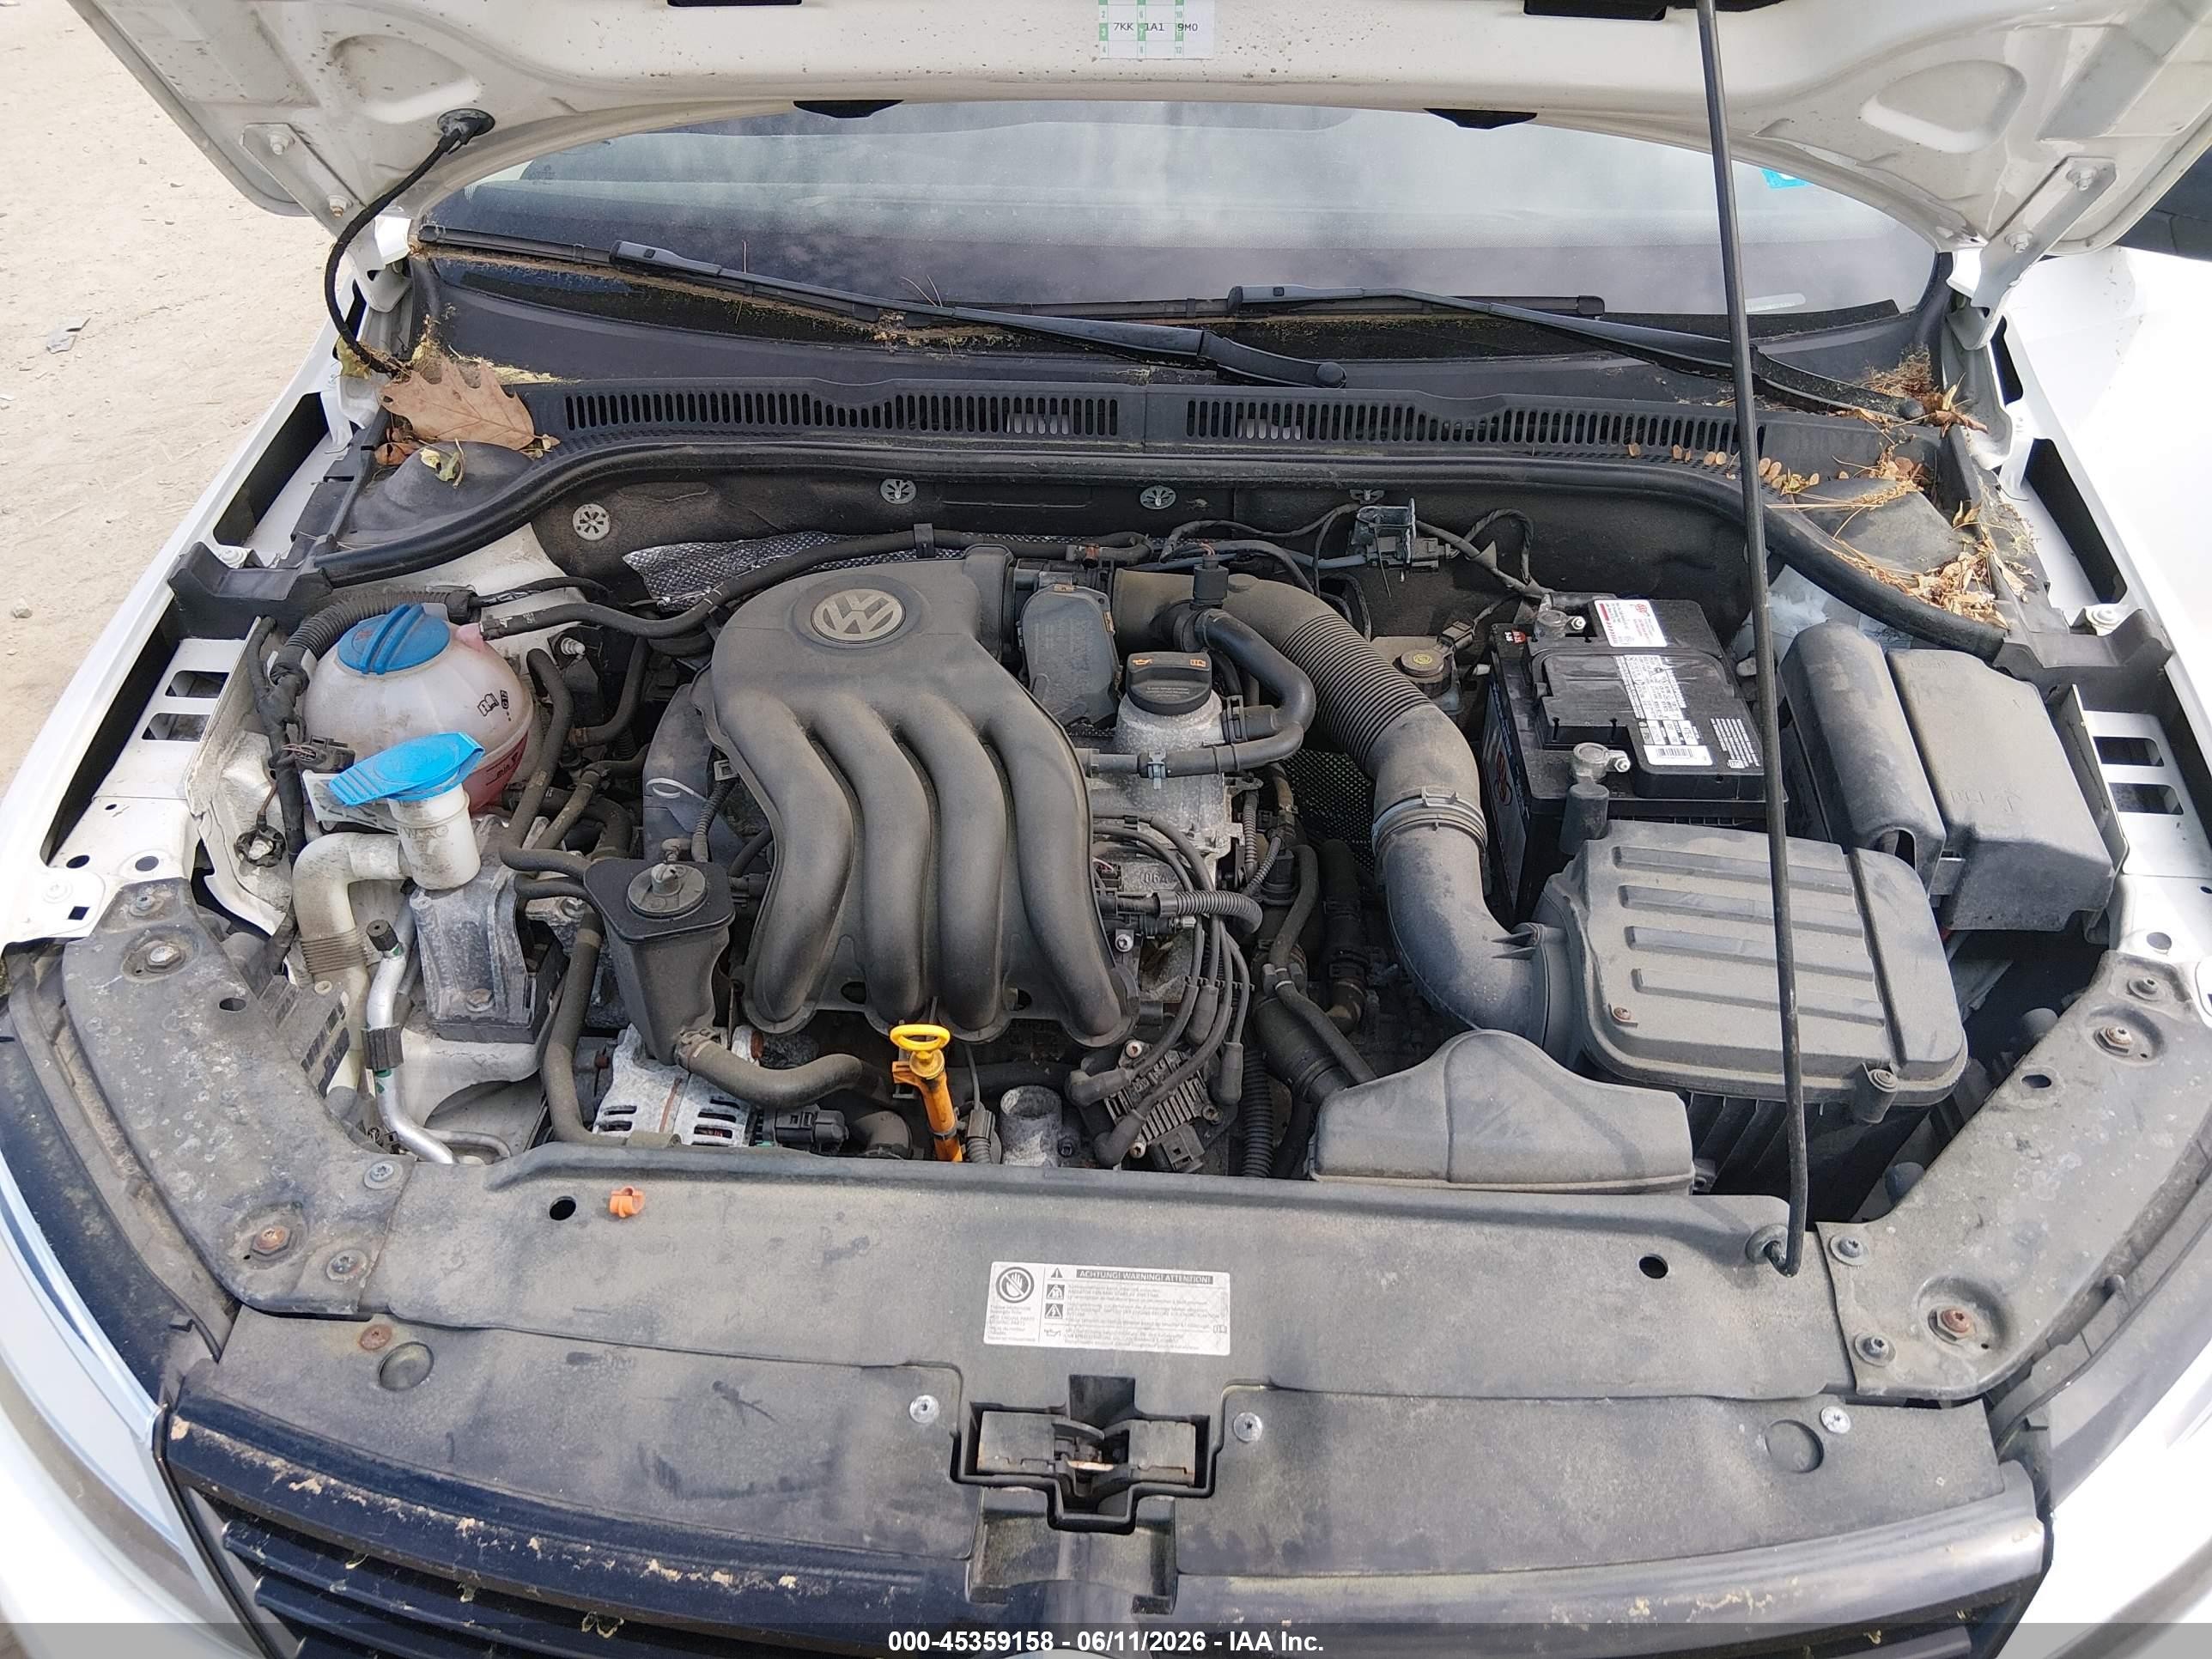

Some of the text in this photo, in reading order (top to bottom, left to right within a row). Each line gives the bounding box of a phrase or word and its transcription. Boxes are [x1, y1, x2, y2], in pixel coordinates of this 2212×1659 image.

[1113, 22, 1133, 31] 7KK
[1145, 22, 1165, 32] 1A1
[811, 588, 905, 643] VW
[496, 764, 510, 778] min
[1079, 1269, 1211, 1285] ACHTUNG! WARNING! ATTENTION!
